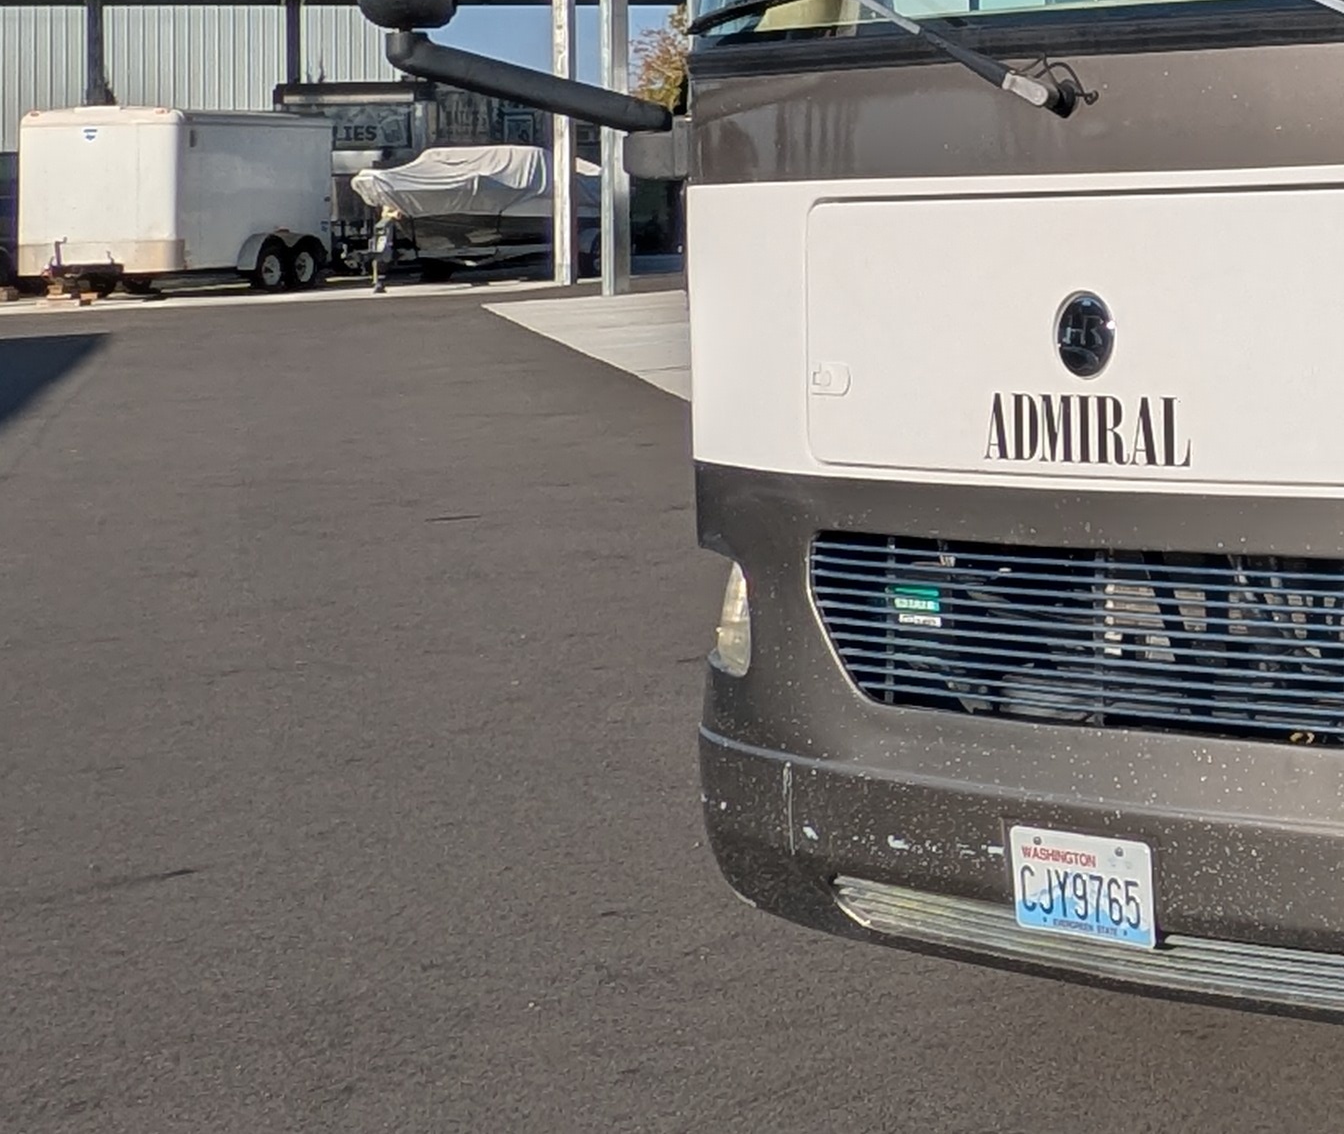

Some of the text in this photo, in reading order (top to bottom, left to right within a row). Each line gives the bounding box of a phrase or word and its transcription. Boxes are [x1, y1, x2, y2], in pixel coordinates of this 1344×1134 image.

[983, 392, 1191, 467] ADMIRAL
[1021, 845, 1097, 867] WASHINGTON
[1020, 865, 1141, 929] CJY9765
